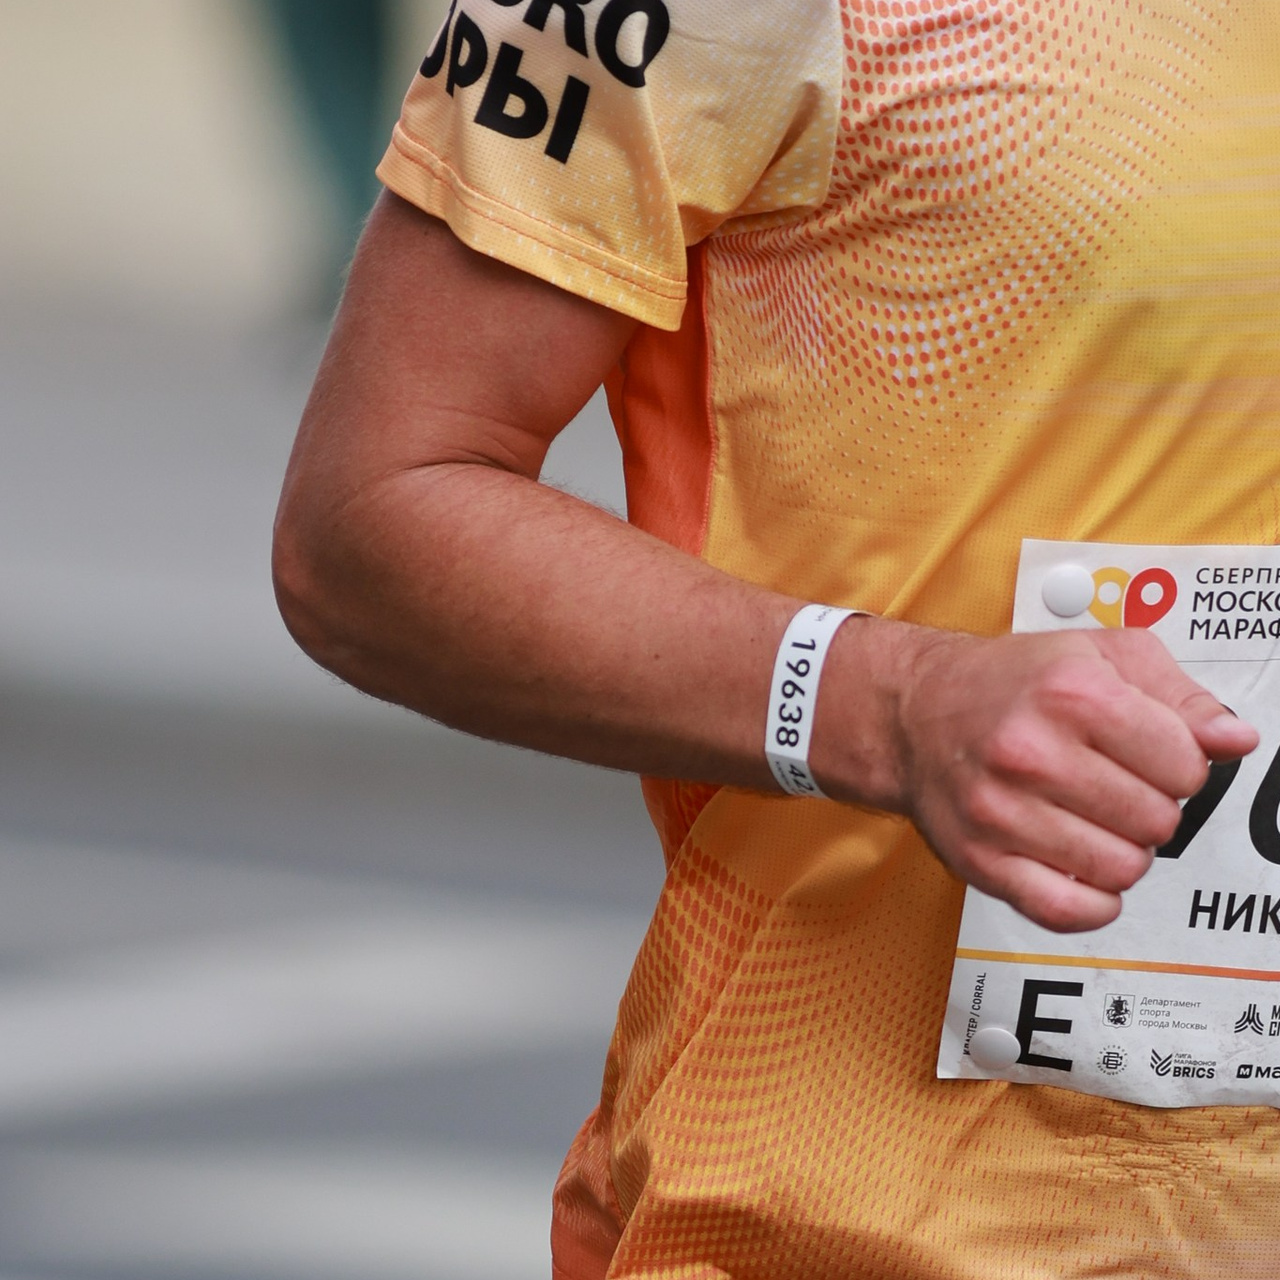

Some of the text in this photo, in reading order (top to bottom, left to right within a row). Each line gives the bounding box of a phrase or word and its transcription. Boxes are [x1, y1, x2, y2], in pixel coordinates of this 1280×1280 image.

[776, 639, 816, 747] 19638
[971, 972, 987, 1011] CORRAL
[1140, 996, 1202, 1008] Департамент
[1139, 1008, 1171, 1018] спорта
[1138, 1019, 1208, 1030] города Москвы
[1172, 1066, 1215, 1079] BRICS
